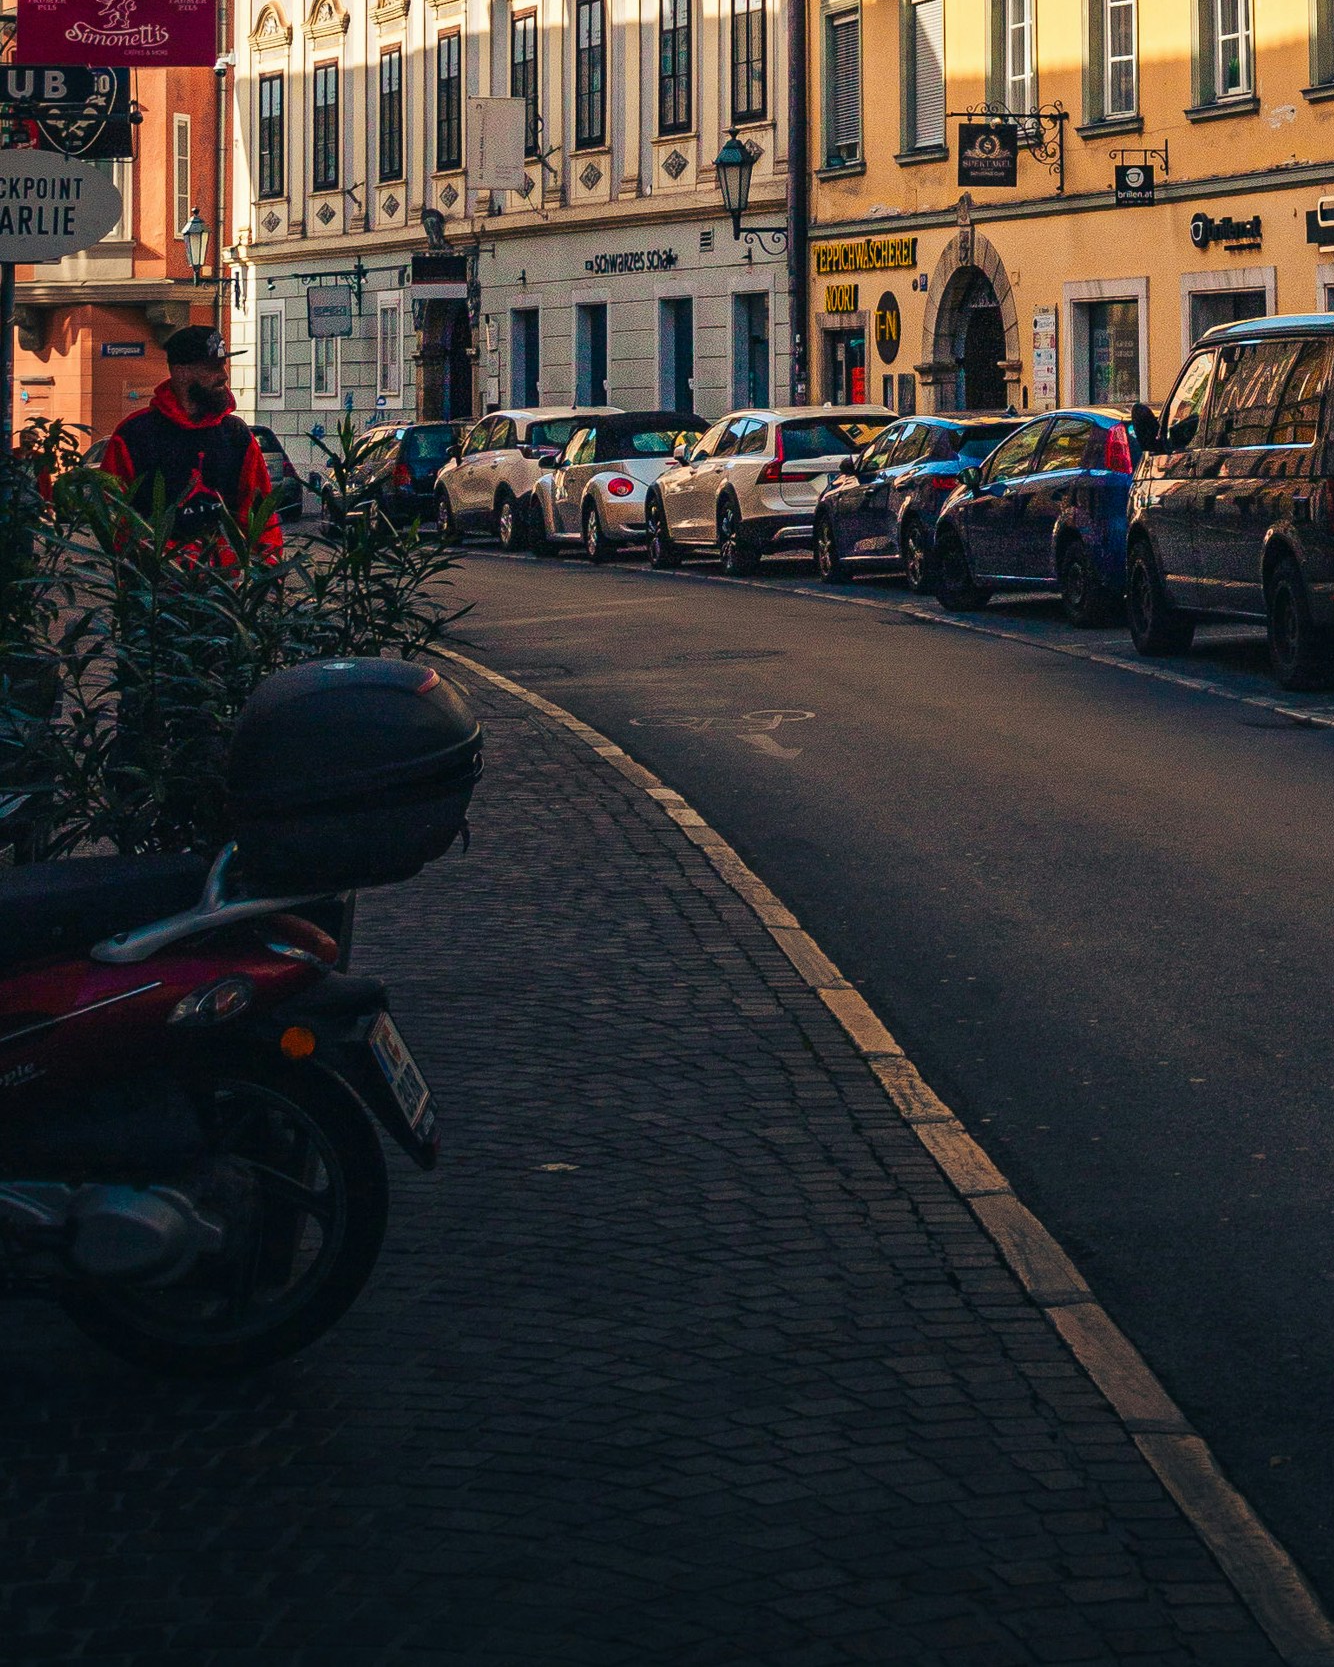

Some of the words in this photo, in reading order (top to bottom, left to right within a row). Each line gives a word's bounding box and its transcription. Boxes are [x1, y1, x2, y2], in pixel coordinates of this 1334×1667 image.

[65, 21, 170, 48] Simonettis
[962, 160, 1012, 168] SPEKTAKEL
[0, 177, 83, 200] CKPOINT
[1117, 190, 1153, 199] brillen.at
[0, 206, 76, 236] ARLIE
[812, 237, 914, 273] TEPPICHWÄSCHEREI
[825, 284, 857, 312] NOORI
[874, 310, 898, 341] T-N
